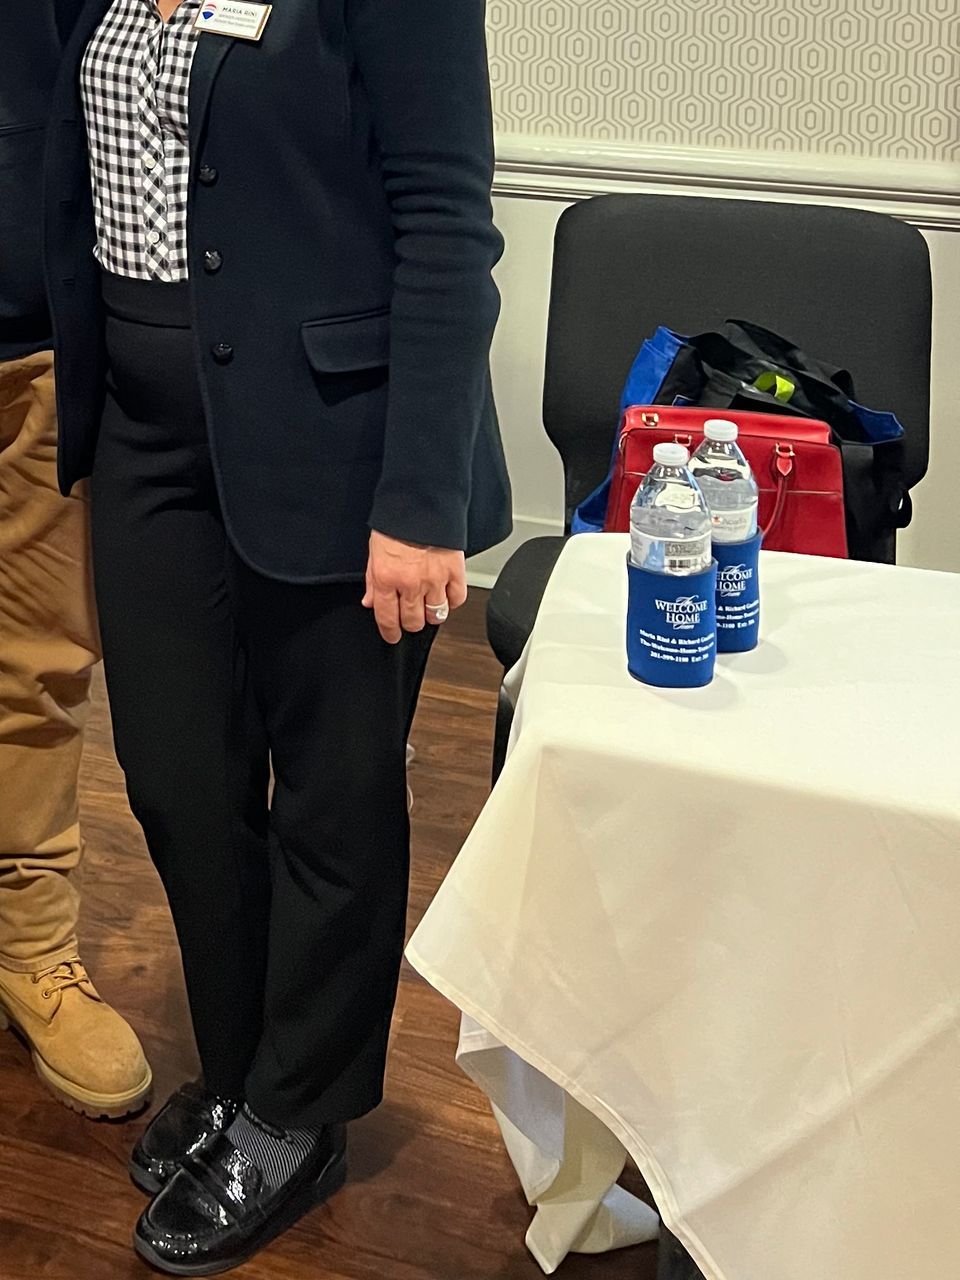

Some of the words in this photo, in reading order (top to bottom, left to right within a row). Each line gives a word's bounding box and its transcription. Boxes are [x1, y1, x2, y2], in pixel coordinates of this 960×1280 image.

[223, 7, 242, 15] MARIA
[655, 599, 708, 614] WELCOME
[666, 612, 700, 624] HOME
